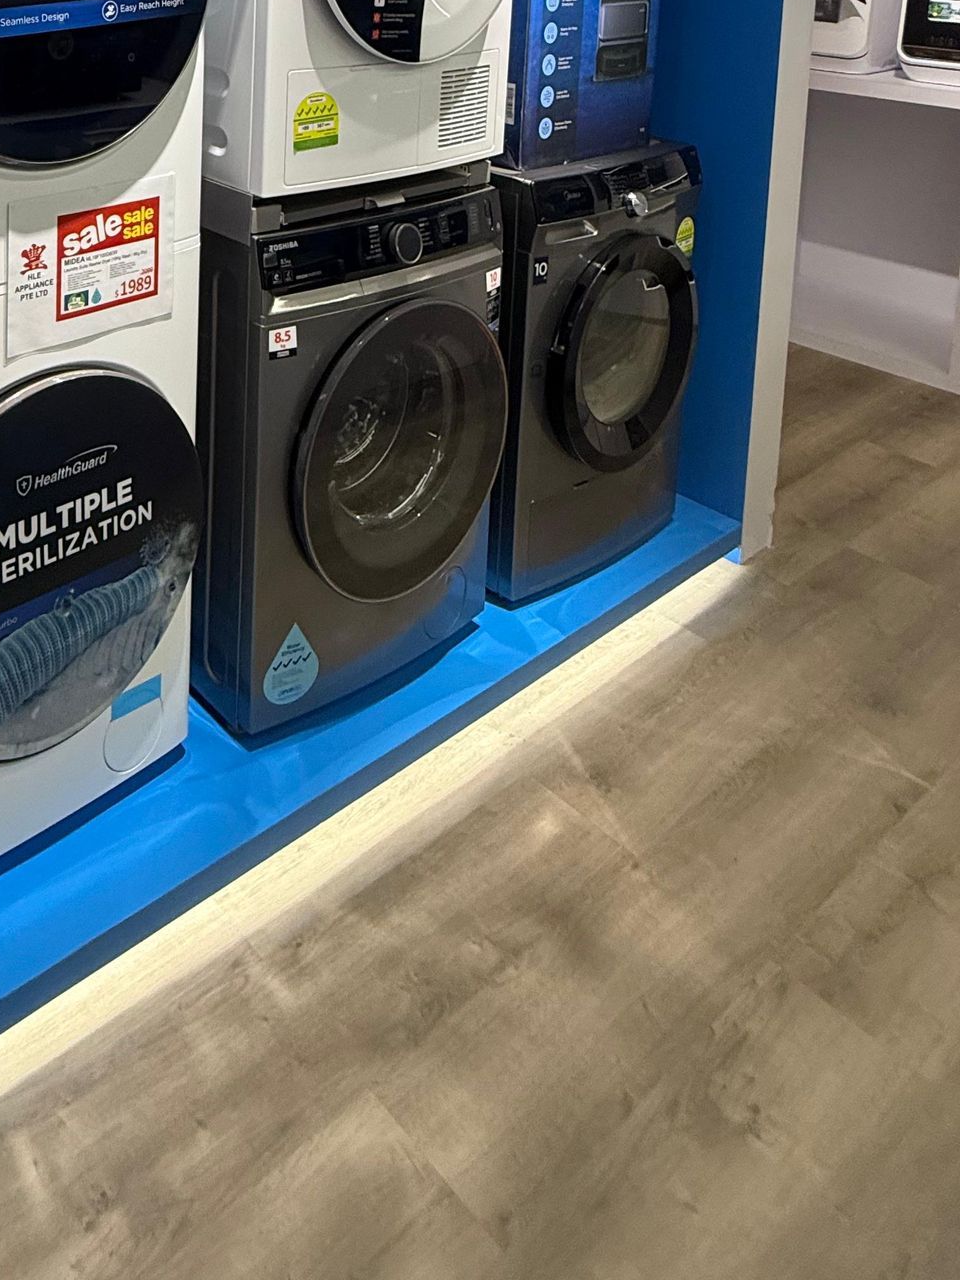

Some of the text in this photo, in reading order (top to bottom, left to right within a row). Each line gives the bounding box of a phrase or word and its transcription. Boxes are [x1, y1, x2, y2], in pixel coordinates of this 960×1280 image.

[120, 3, 137, 14] Easy
[138, 0, 160, 10] Reach
[0, 14, 39, 28] Seamless
[41, 11, 70, 24] Design
[123, 206, 154, 225] sale
[62, 214, 123, 256] sale
[123, 221, 154, 239] sale
[268, 241, 298, 253] TOSHIBA
[64, 257, 85, 266] MIDEA
[28, 272, 41, 280] HLE
[534, 262, 548, 276] 10
[490, 271, 497, 283] 10
[15, 279, 54, 293] APPLIANCE
[20, 289, 49, 301] PTE LTD
[274, 330, 291, 344] 8.5
[34, 451, 108, 490] HealthGuard
